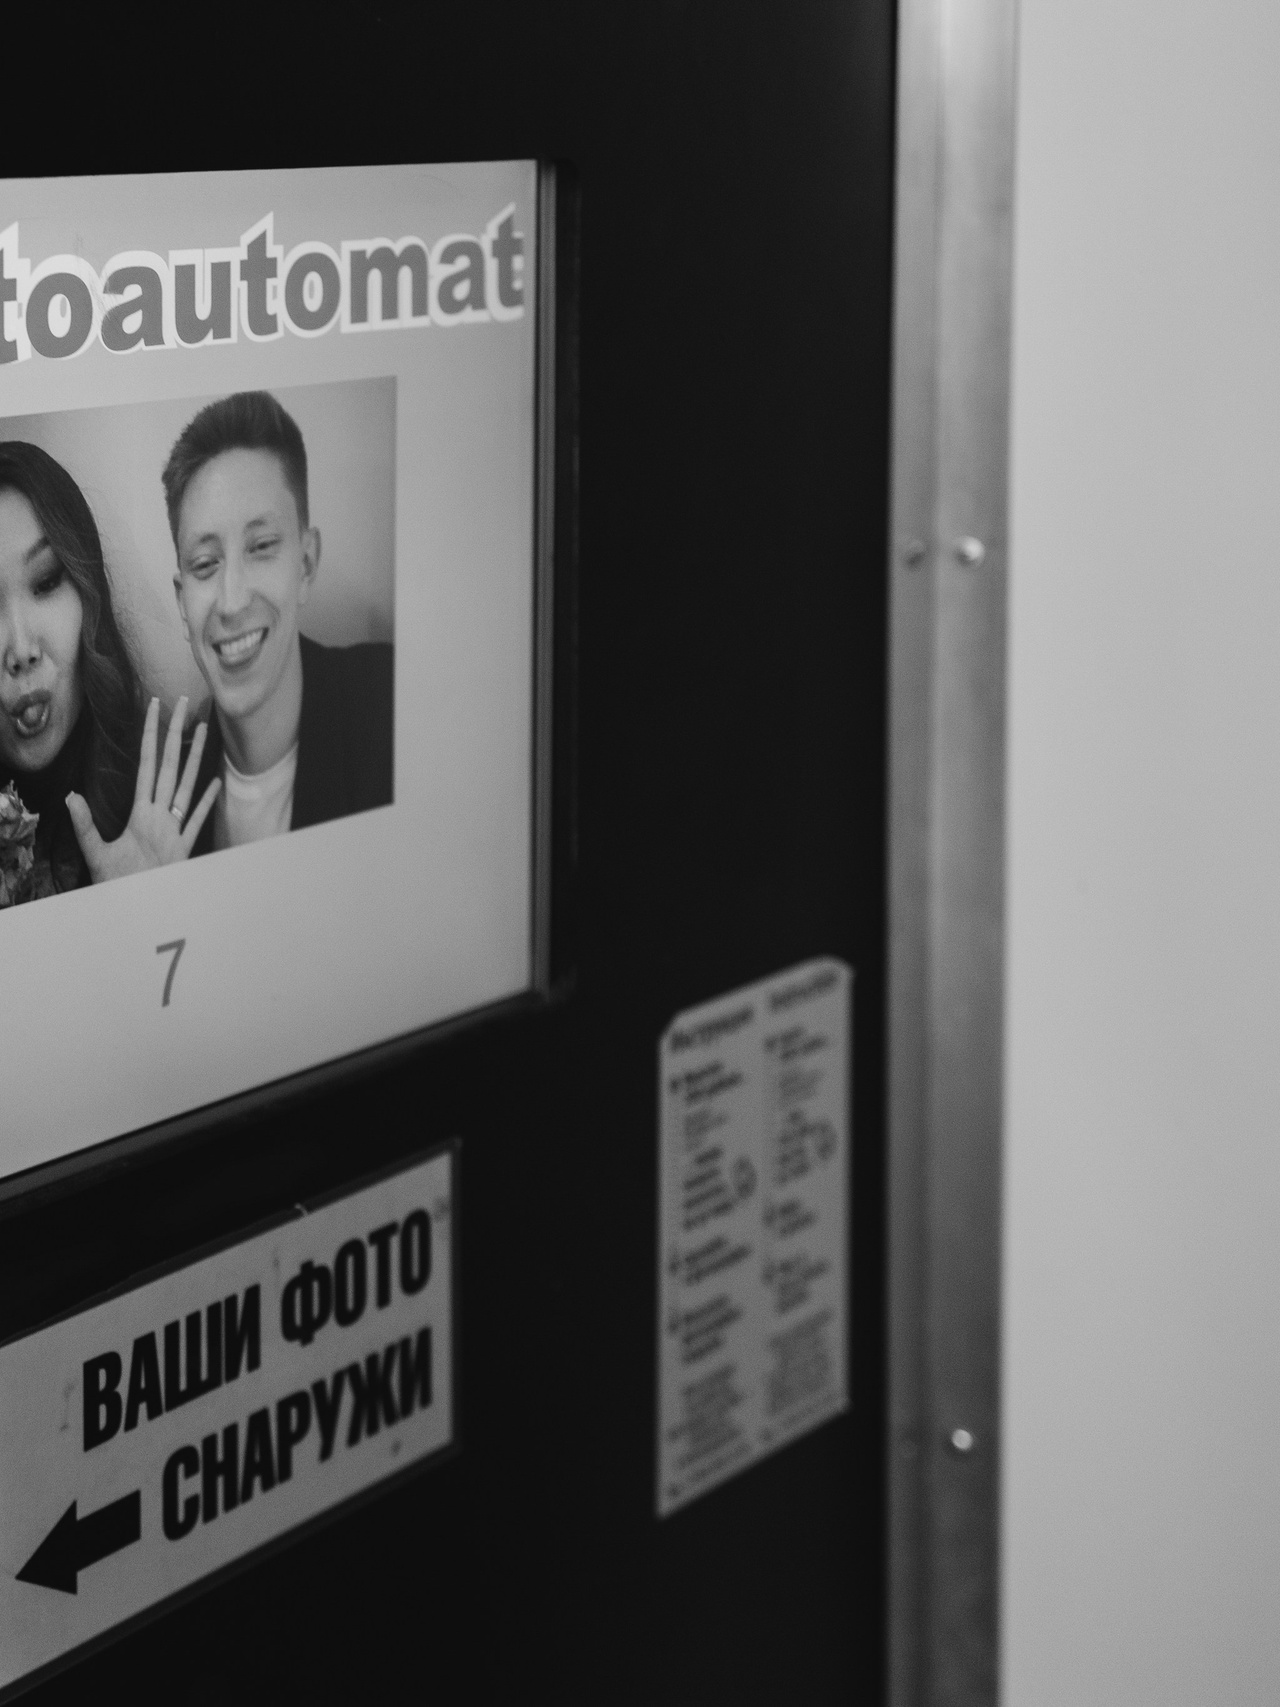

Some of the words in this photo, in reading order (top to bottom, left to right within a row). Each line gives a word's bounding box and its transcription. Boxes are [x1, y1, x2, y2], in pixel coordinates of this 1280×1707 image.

[156, 939, 186, 1007] 7
[83, 1282, 261, 1453] ВАШИ
[280, 1208, 432, 1347] ФОТО
[161, 1326, 432, 1542] СНАРУЖИ
